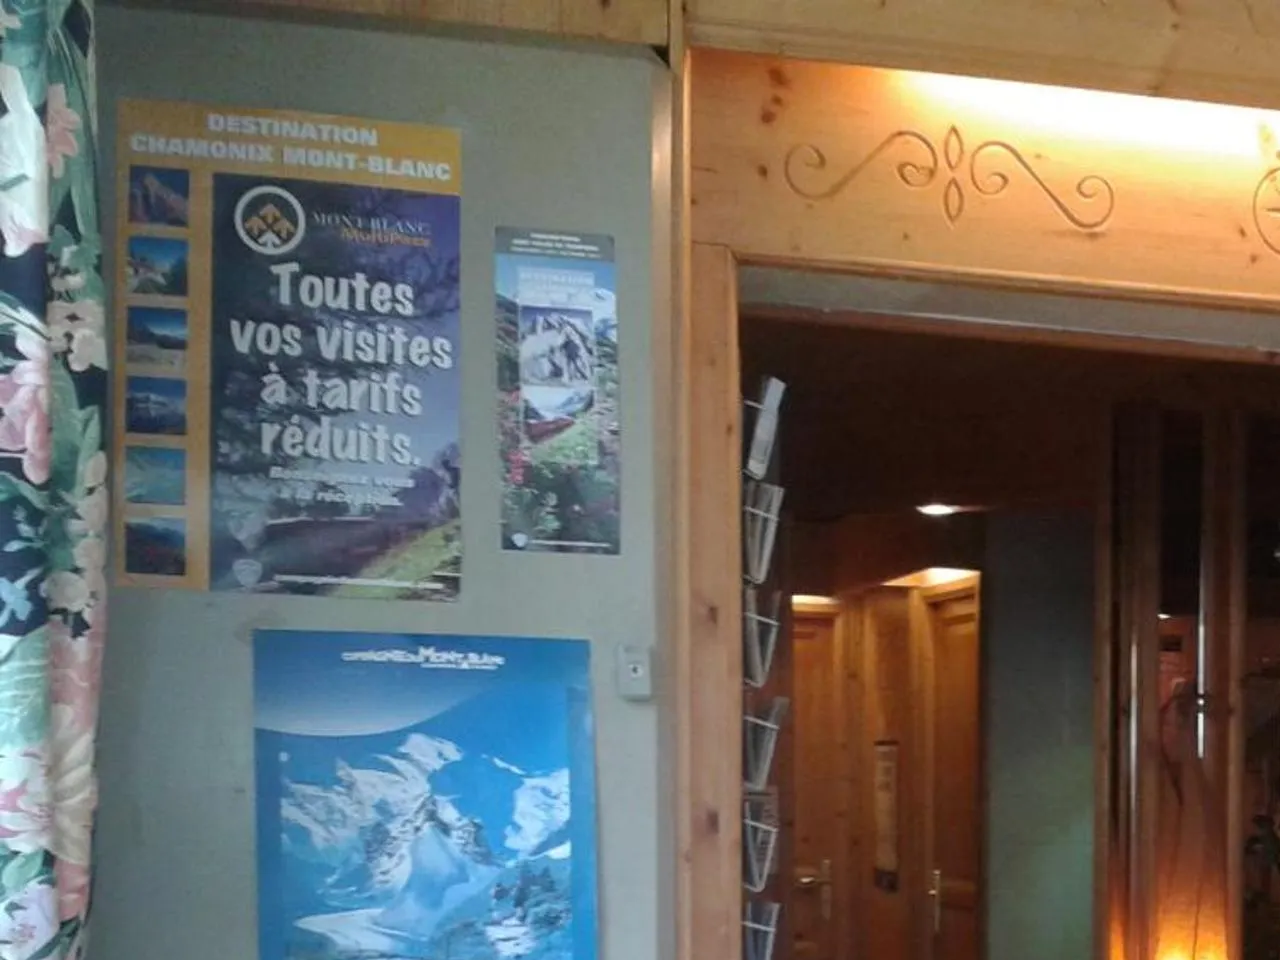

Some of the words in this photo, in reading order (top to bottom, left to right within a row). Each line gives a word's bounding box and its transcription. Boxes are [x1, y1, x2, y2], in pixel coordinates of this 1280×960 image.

[206, 112, 379, 147] DESTINATION
[129, 133, 274, 164] CHAMONIX
[282, 144, 453, 181] MONT-BLANC
[269, 262, 414, 317] Toutes
[229, 318, 303, 358] vos
[316, 320, 453, 370] visites
[260, 361, 288, 405] à
[302, 368, 423, 417] tarifs
[260, 414, 423, 466] réduits.
